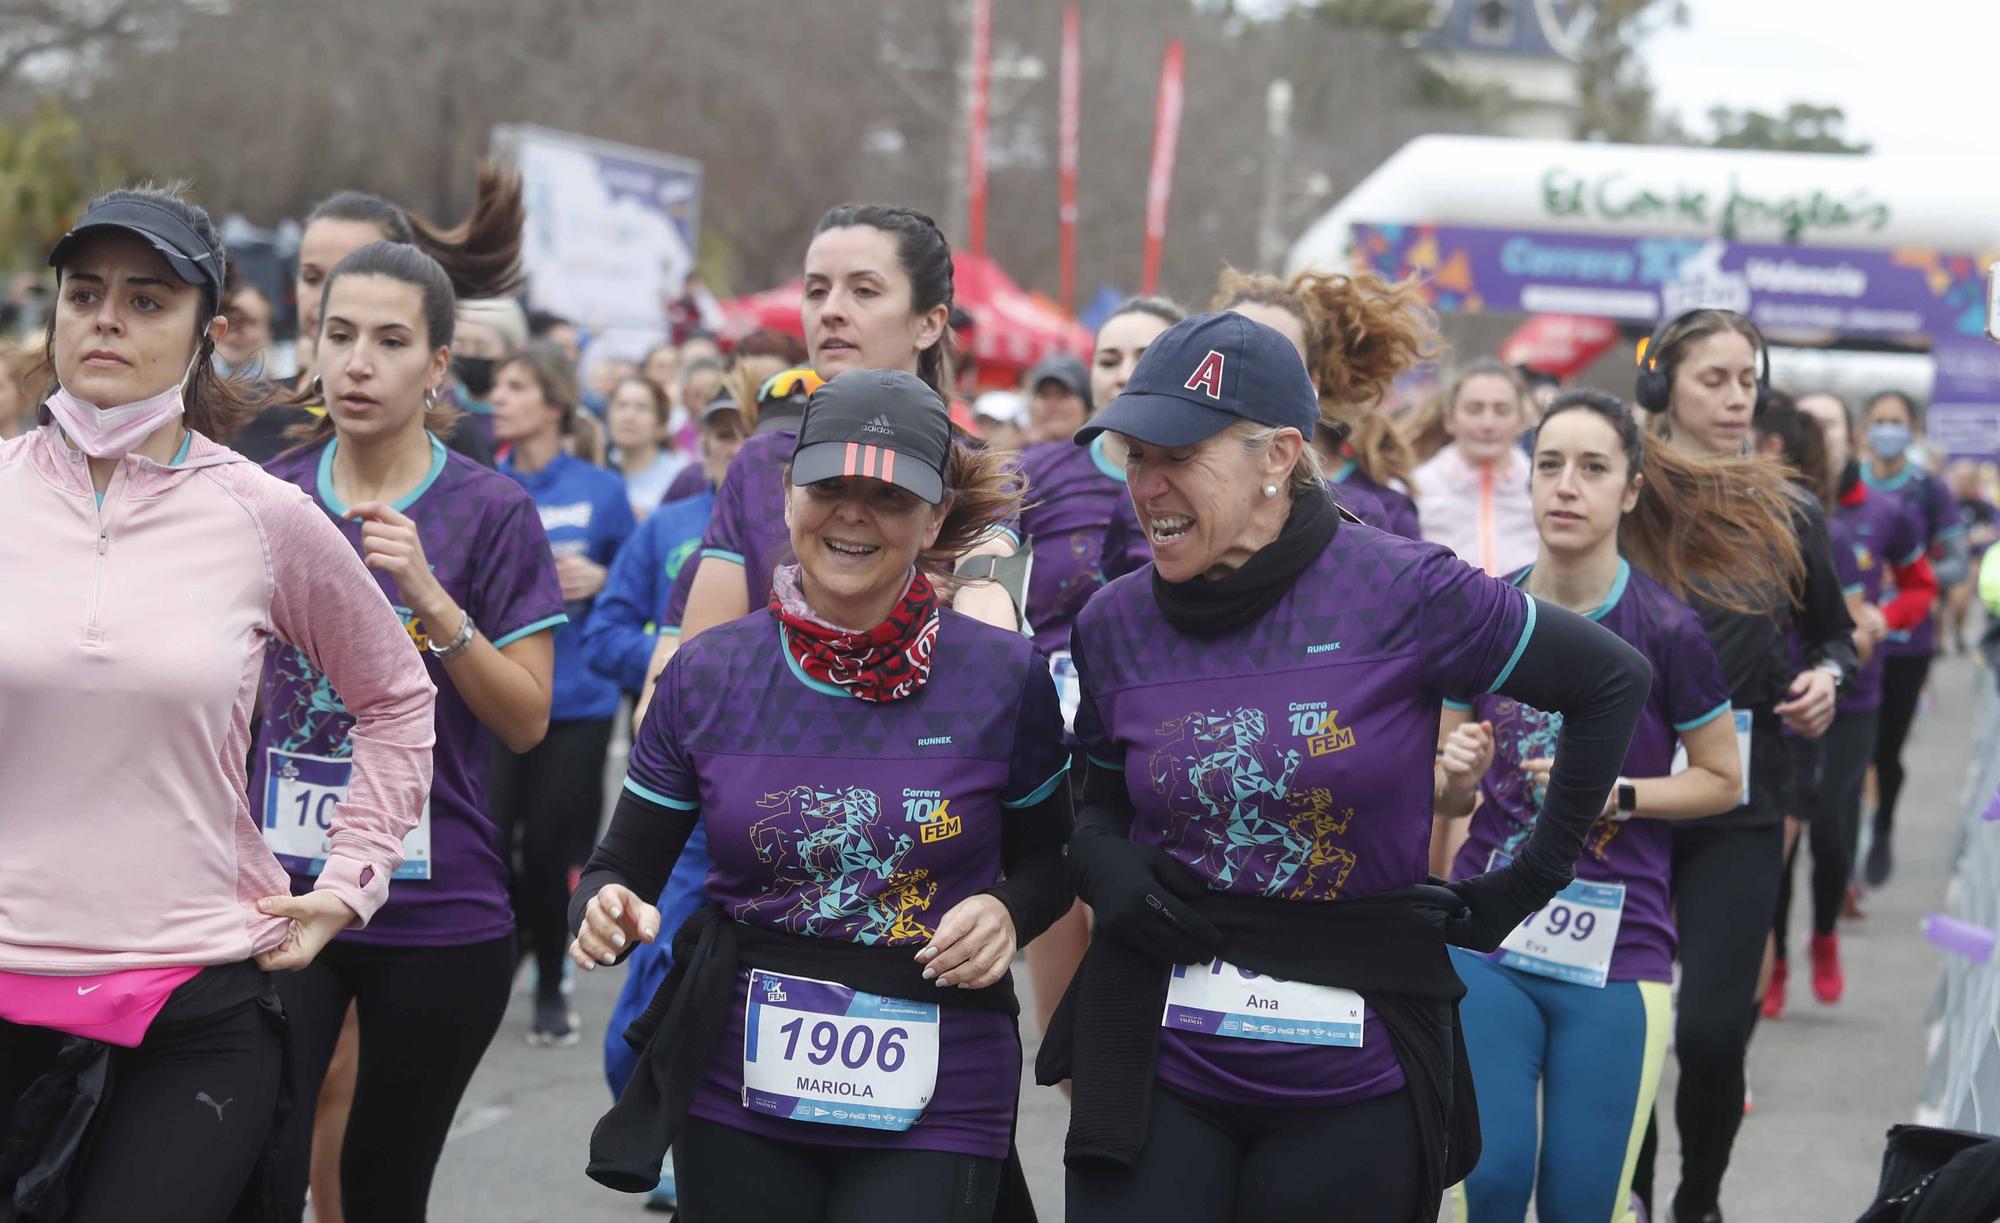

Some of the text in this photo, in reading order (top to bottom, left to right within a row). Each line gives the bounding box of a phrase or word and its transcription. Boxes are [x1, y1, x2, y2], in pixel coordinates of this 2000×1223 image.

[1183, 349, 1225, 400] A
[861, 424, 895, 436] adidas
[1306, 642, 1341, 654] RUNNEK
[1288, 701, 1328, 712] Carrera
[1288, 710, 1338, 737] 10K
[918, 736, 952, 746] RUNNEK
[1311, 730, 1352, 753] FEM
[902, 787, 941, 798] Carrera
[902, 798, 950, 823] 10K
[924, 818, 959, 841] FEM
[762, 980, 782, 993] 10K
[769, 993, 785, 1001] FEM
[1246, 994, 1279, 1011] Ana
[1349, 1009, 1358, 1018] M
[779, 1016, 909, 1073] 1906
[796, 1076, 874, 1099] MARIOLA
[919, 1095, 928, 1105] M
